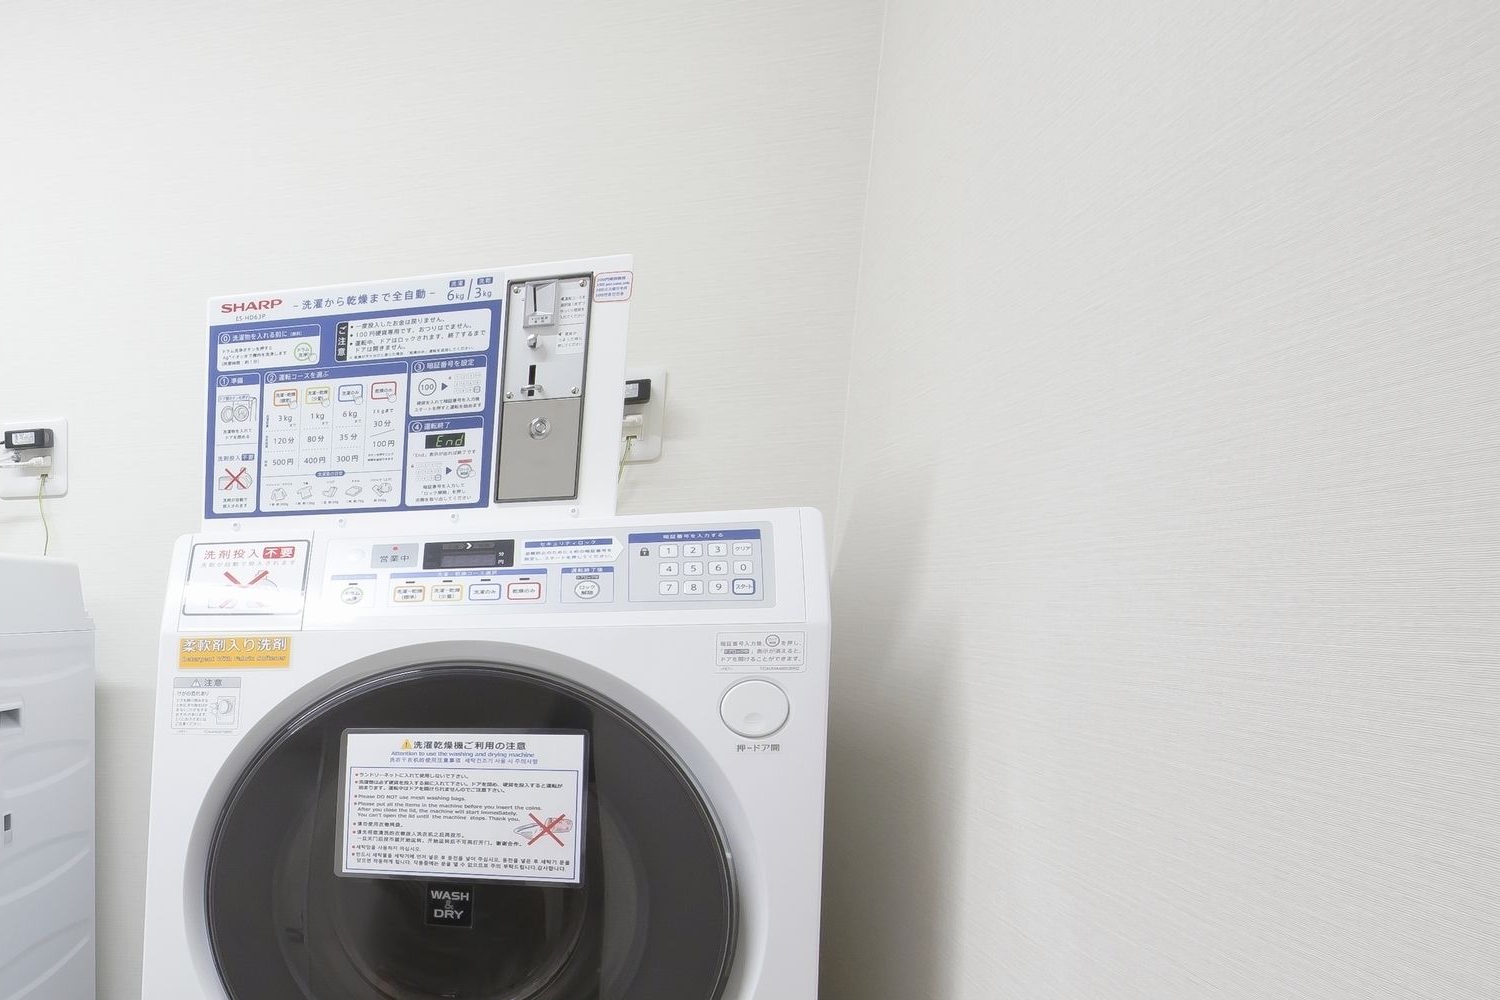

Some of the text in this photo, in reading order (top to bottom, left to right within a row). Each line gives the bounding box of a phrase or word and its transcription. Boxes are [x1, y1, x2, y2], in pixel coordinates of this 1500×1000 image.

[221, 299, 282, 313] SHARP
[436, 435, 464, 447] End
[183, 638, 286, 652] 柔軟剤入り洗剤
[414, 741, 526, 750] 洗濯乾燥機ご利用の注意
[431, 890, 469, 901] WASH
[445, 900, 454, 909] &
[434, 909, 464, 919] DRY
